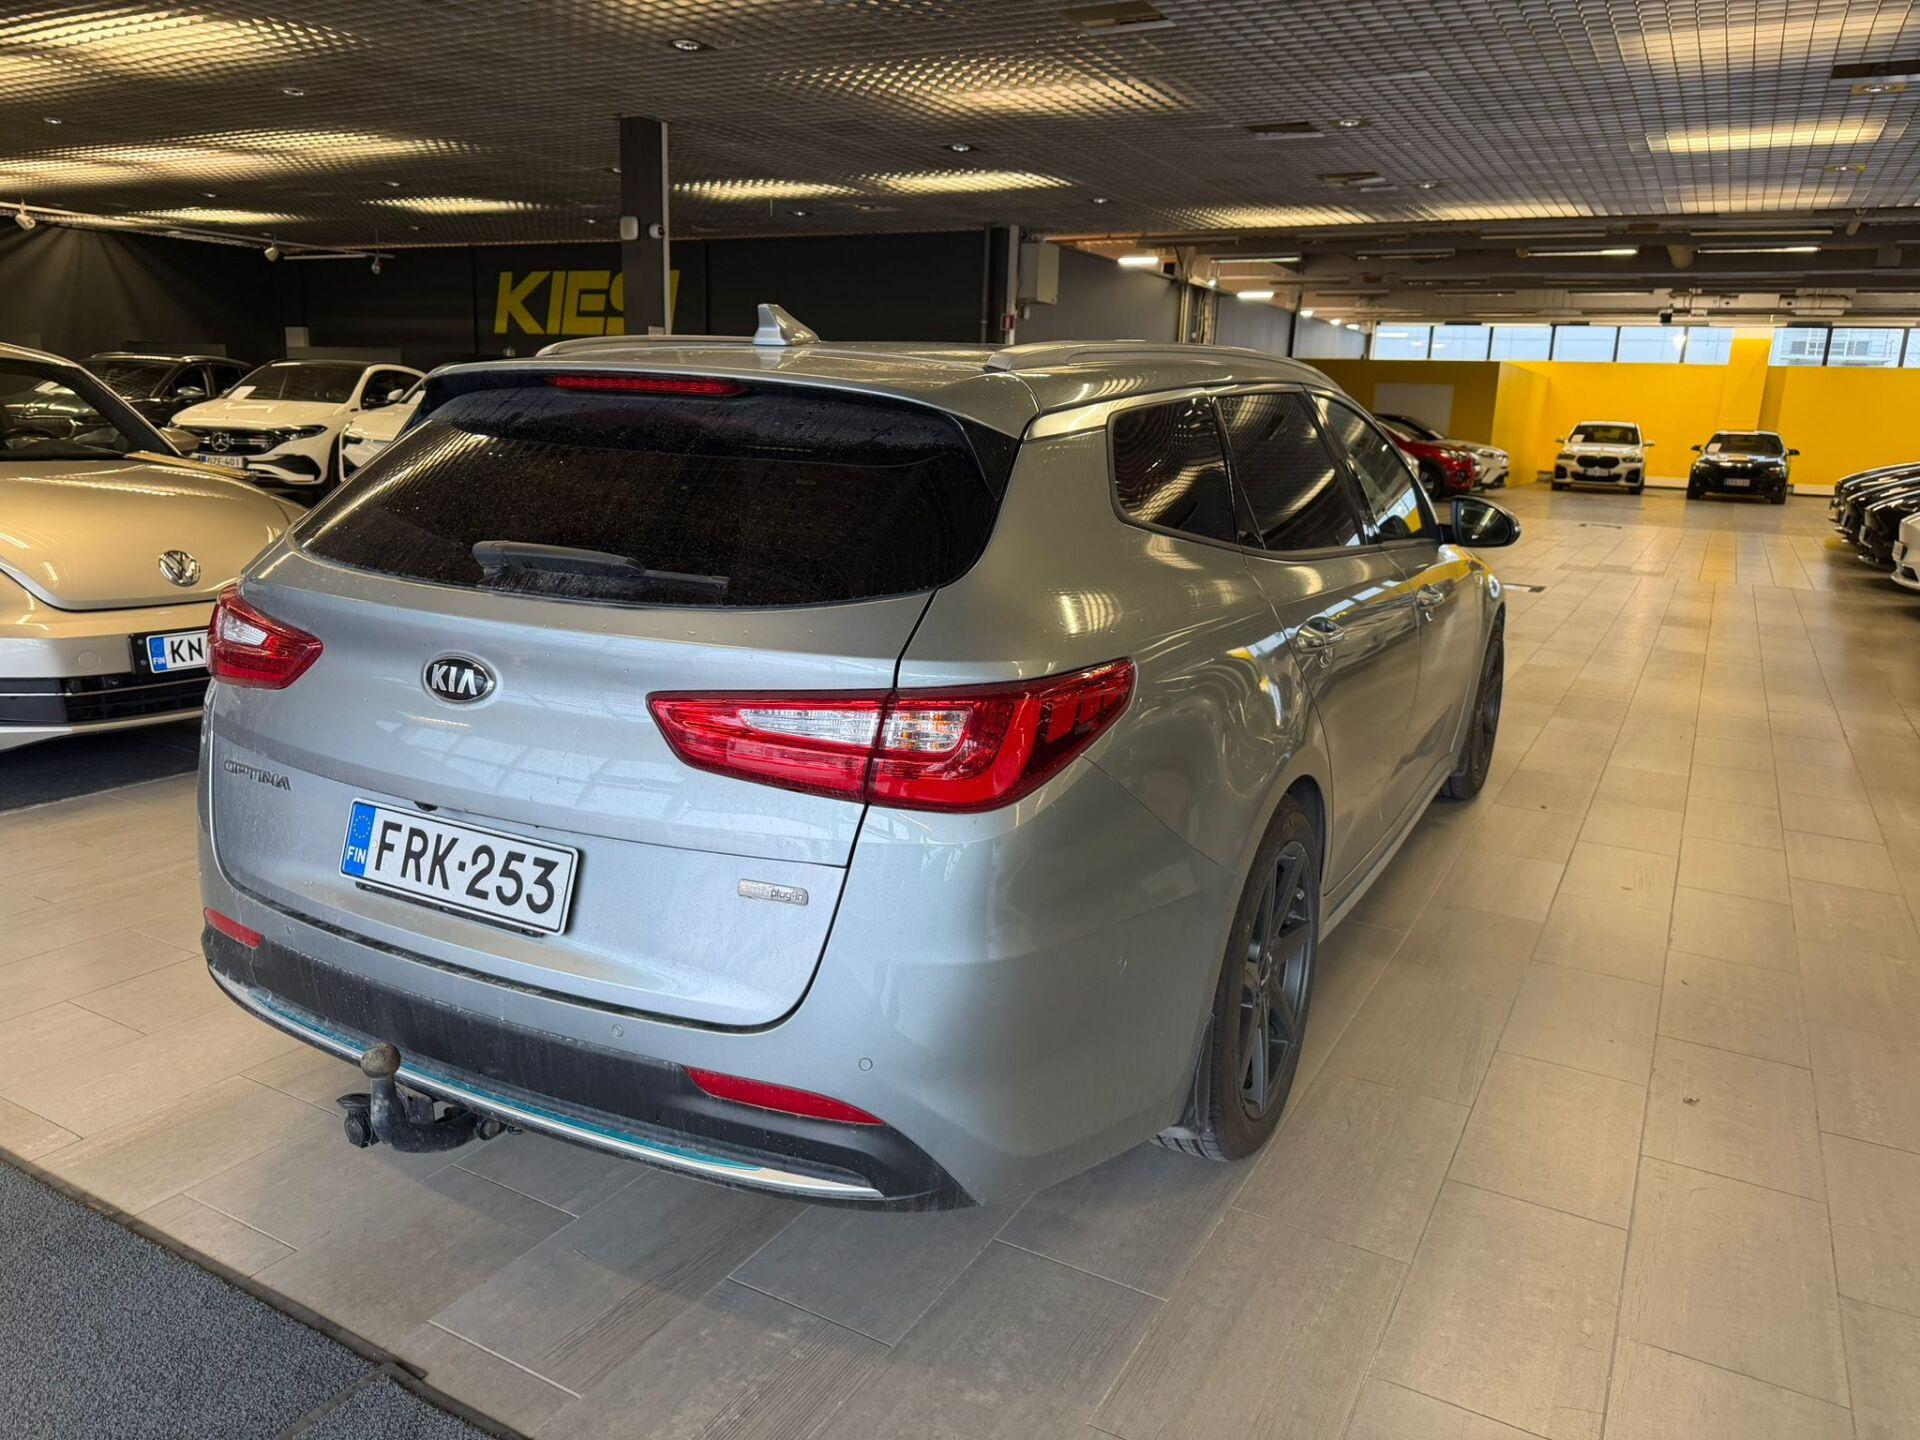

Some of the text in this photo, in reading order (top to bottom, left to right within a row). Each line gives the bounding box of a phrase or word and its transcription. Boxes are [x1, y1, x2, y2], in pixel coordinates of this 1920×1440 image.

[153, 657, 166, 666] FIN
[431, 664, 478, 695] KIA
[224, 760, 291, 791] OPTIMA
[346, 845, 367, 864] FIN
[374, 820, 560, 915] FRK-253
[770, 888, 804, 902] plug-in
